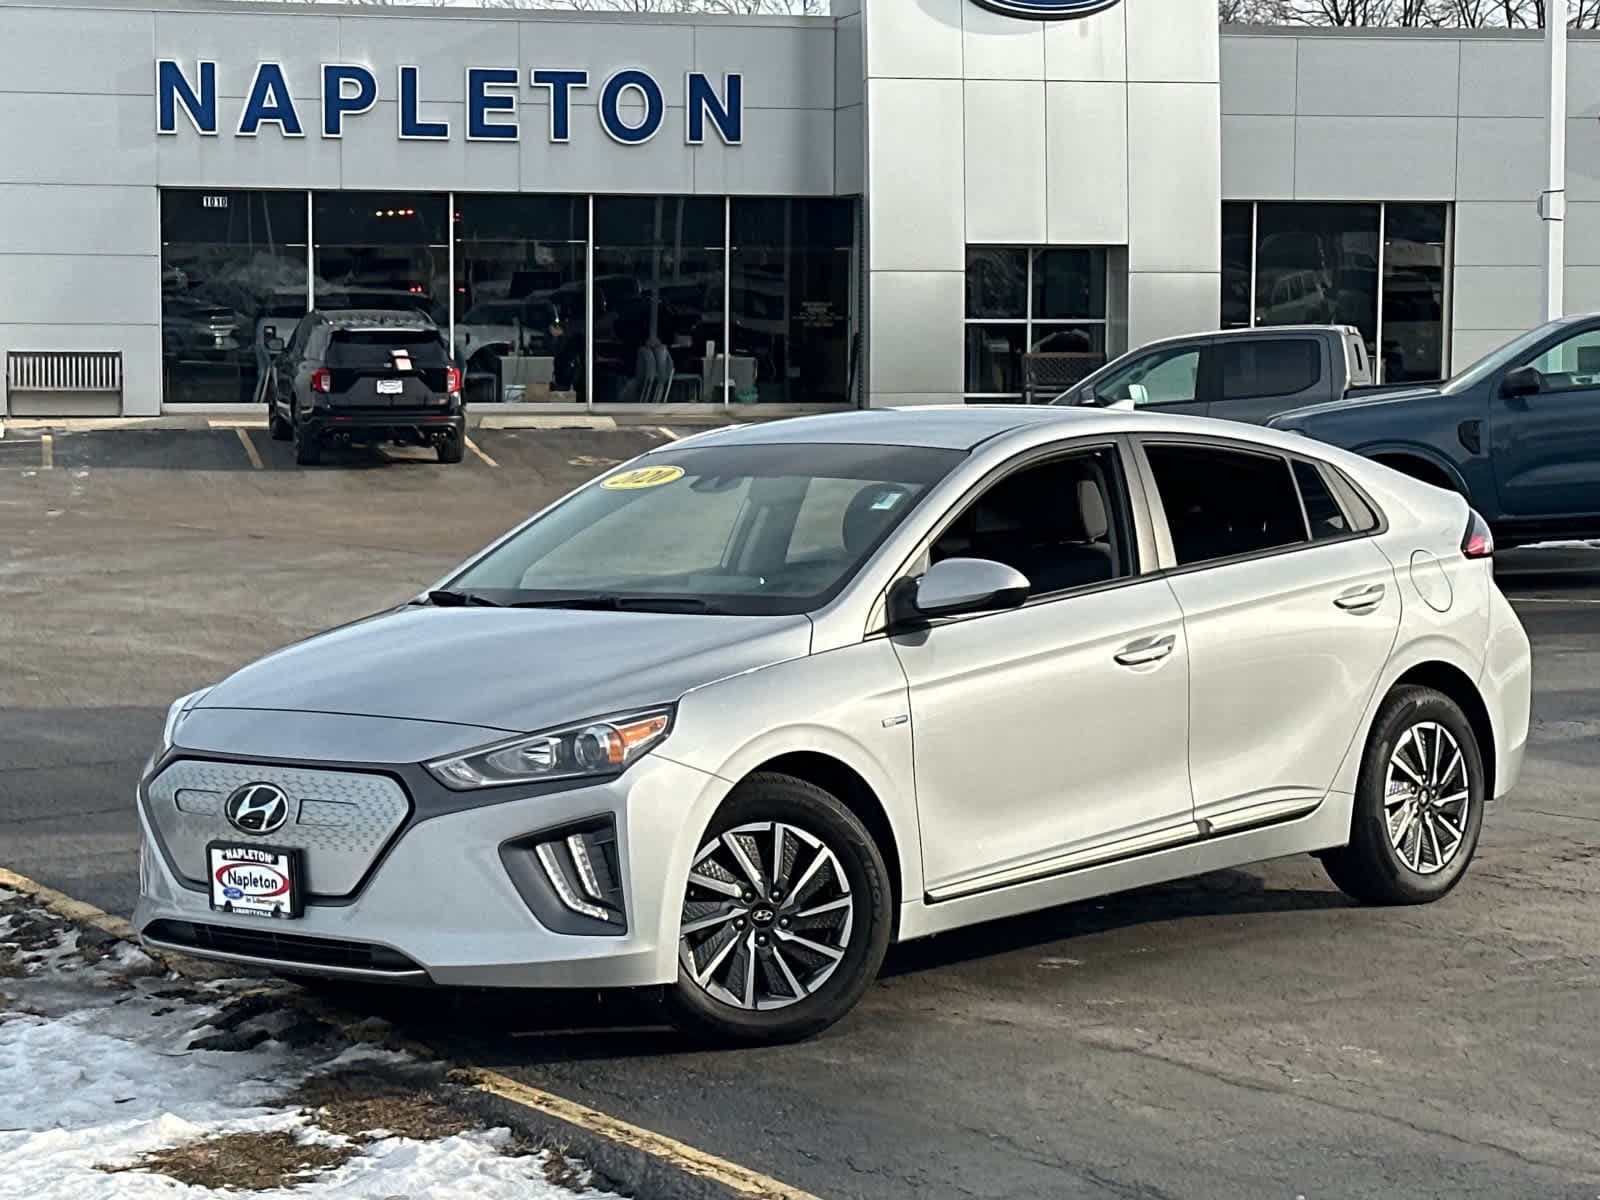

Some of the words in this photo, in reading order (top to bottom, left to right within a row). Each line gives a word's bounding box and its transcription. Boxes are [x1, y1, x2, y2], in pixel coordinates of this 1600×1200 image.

[155, 58, 743, 145] NAPLETON
[204, 196, 228, 208] 1010
[225, 848, 274, 863] NAPLETON
[228, 870, 278, 889] Napleton
